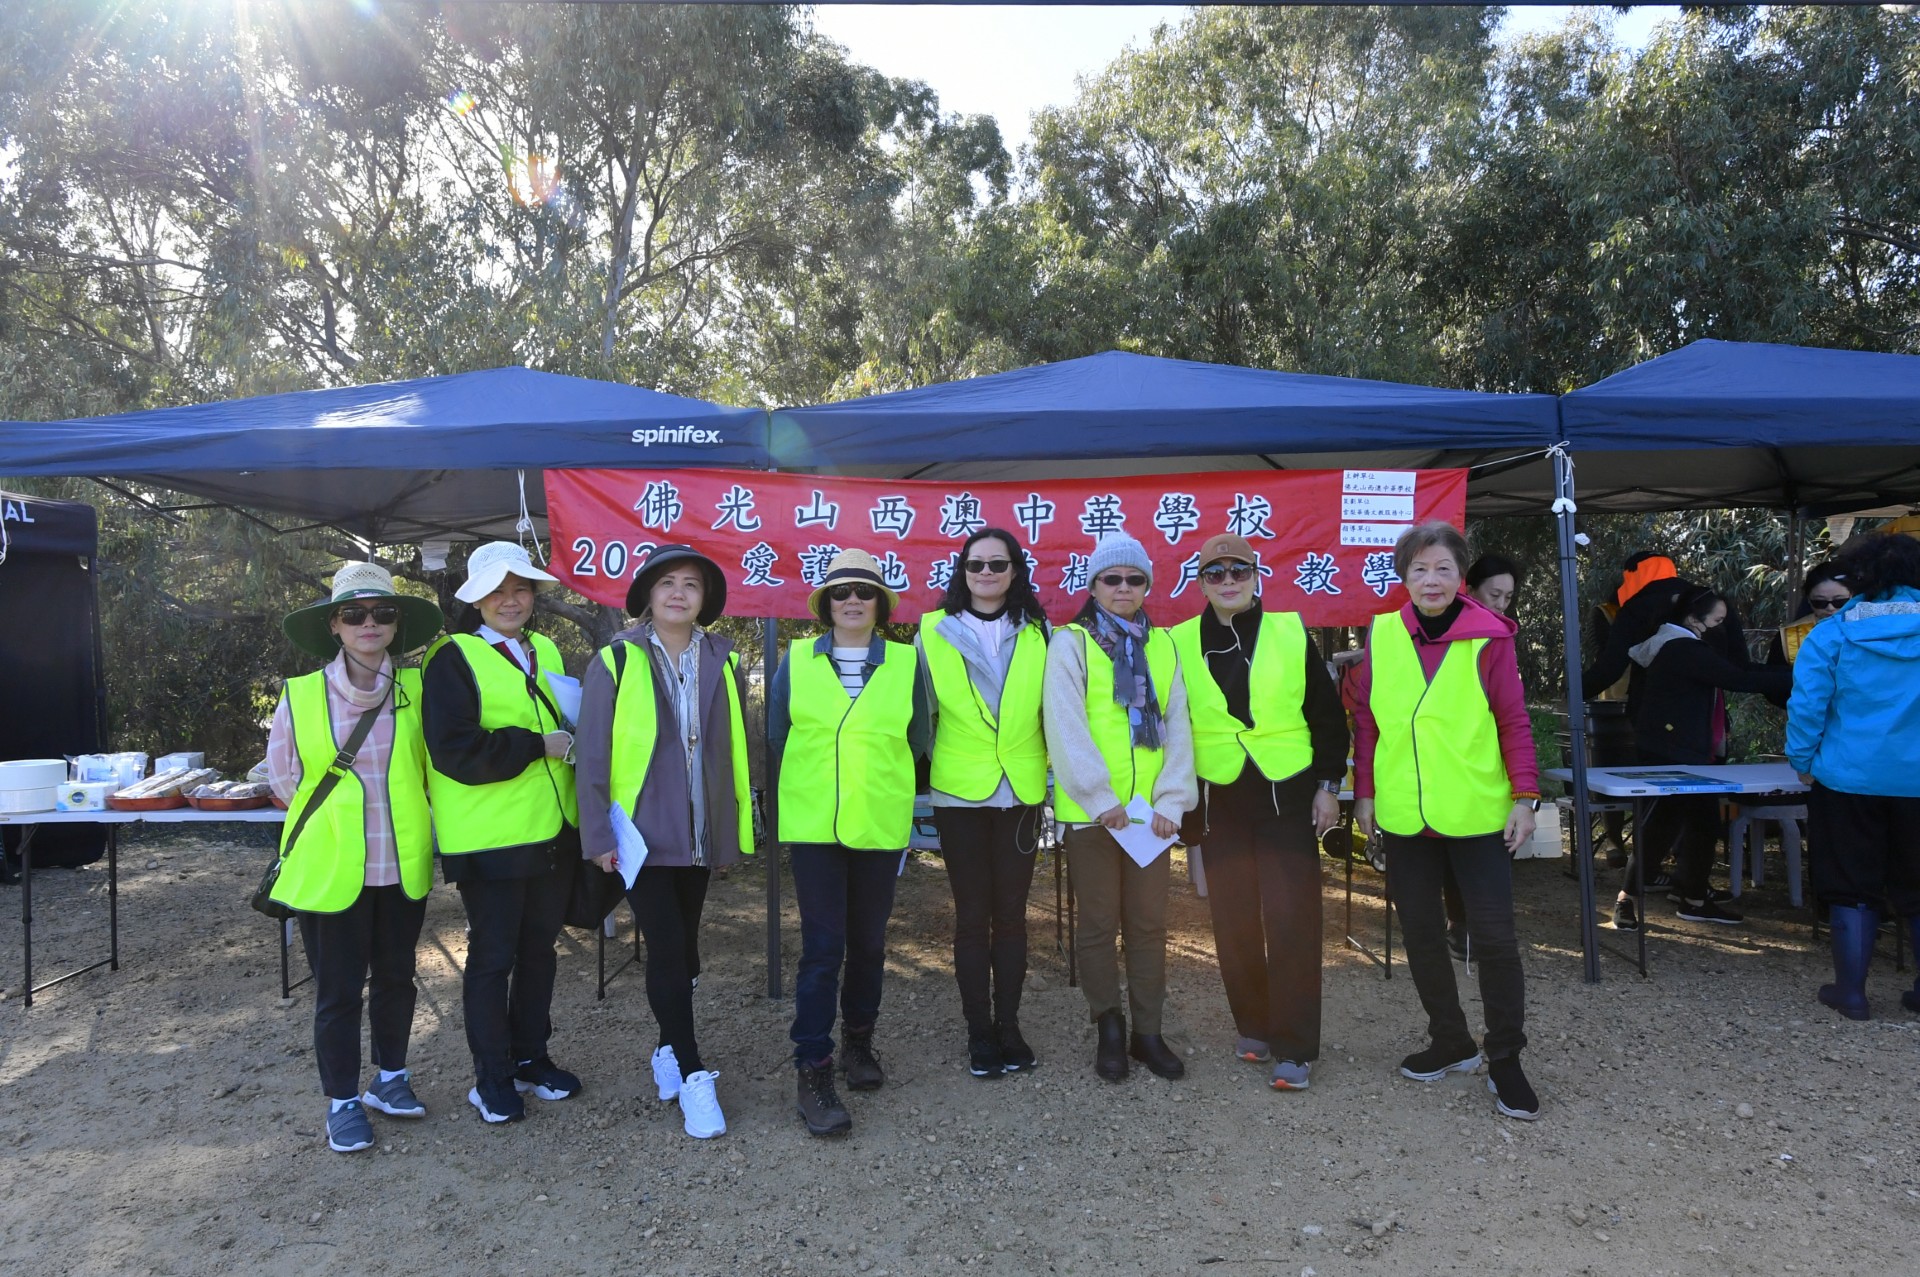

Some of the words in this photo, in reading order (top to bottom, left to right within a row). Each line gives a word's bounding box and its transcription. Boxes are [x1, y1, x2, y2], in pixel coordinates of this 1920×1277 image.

[4, 500, 35, 523] AL
[634, 479, 1277, 545] 佛光山西澳中華學校
[1341, 536, 1399, 545] 中華民國僑務委
[572, 537, 691, 579] 202
